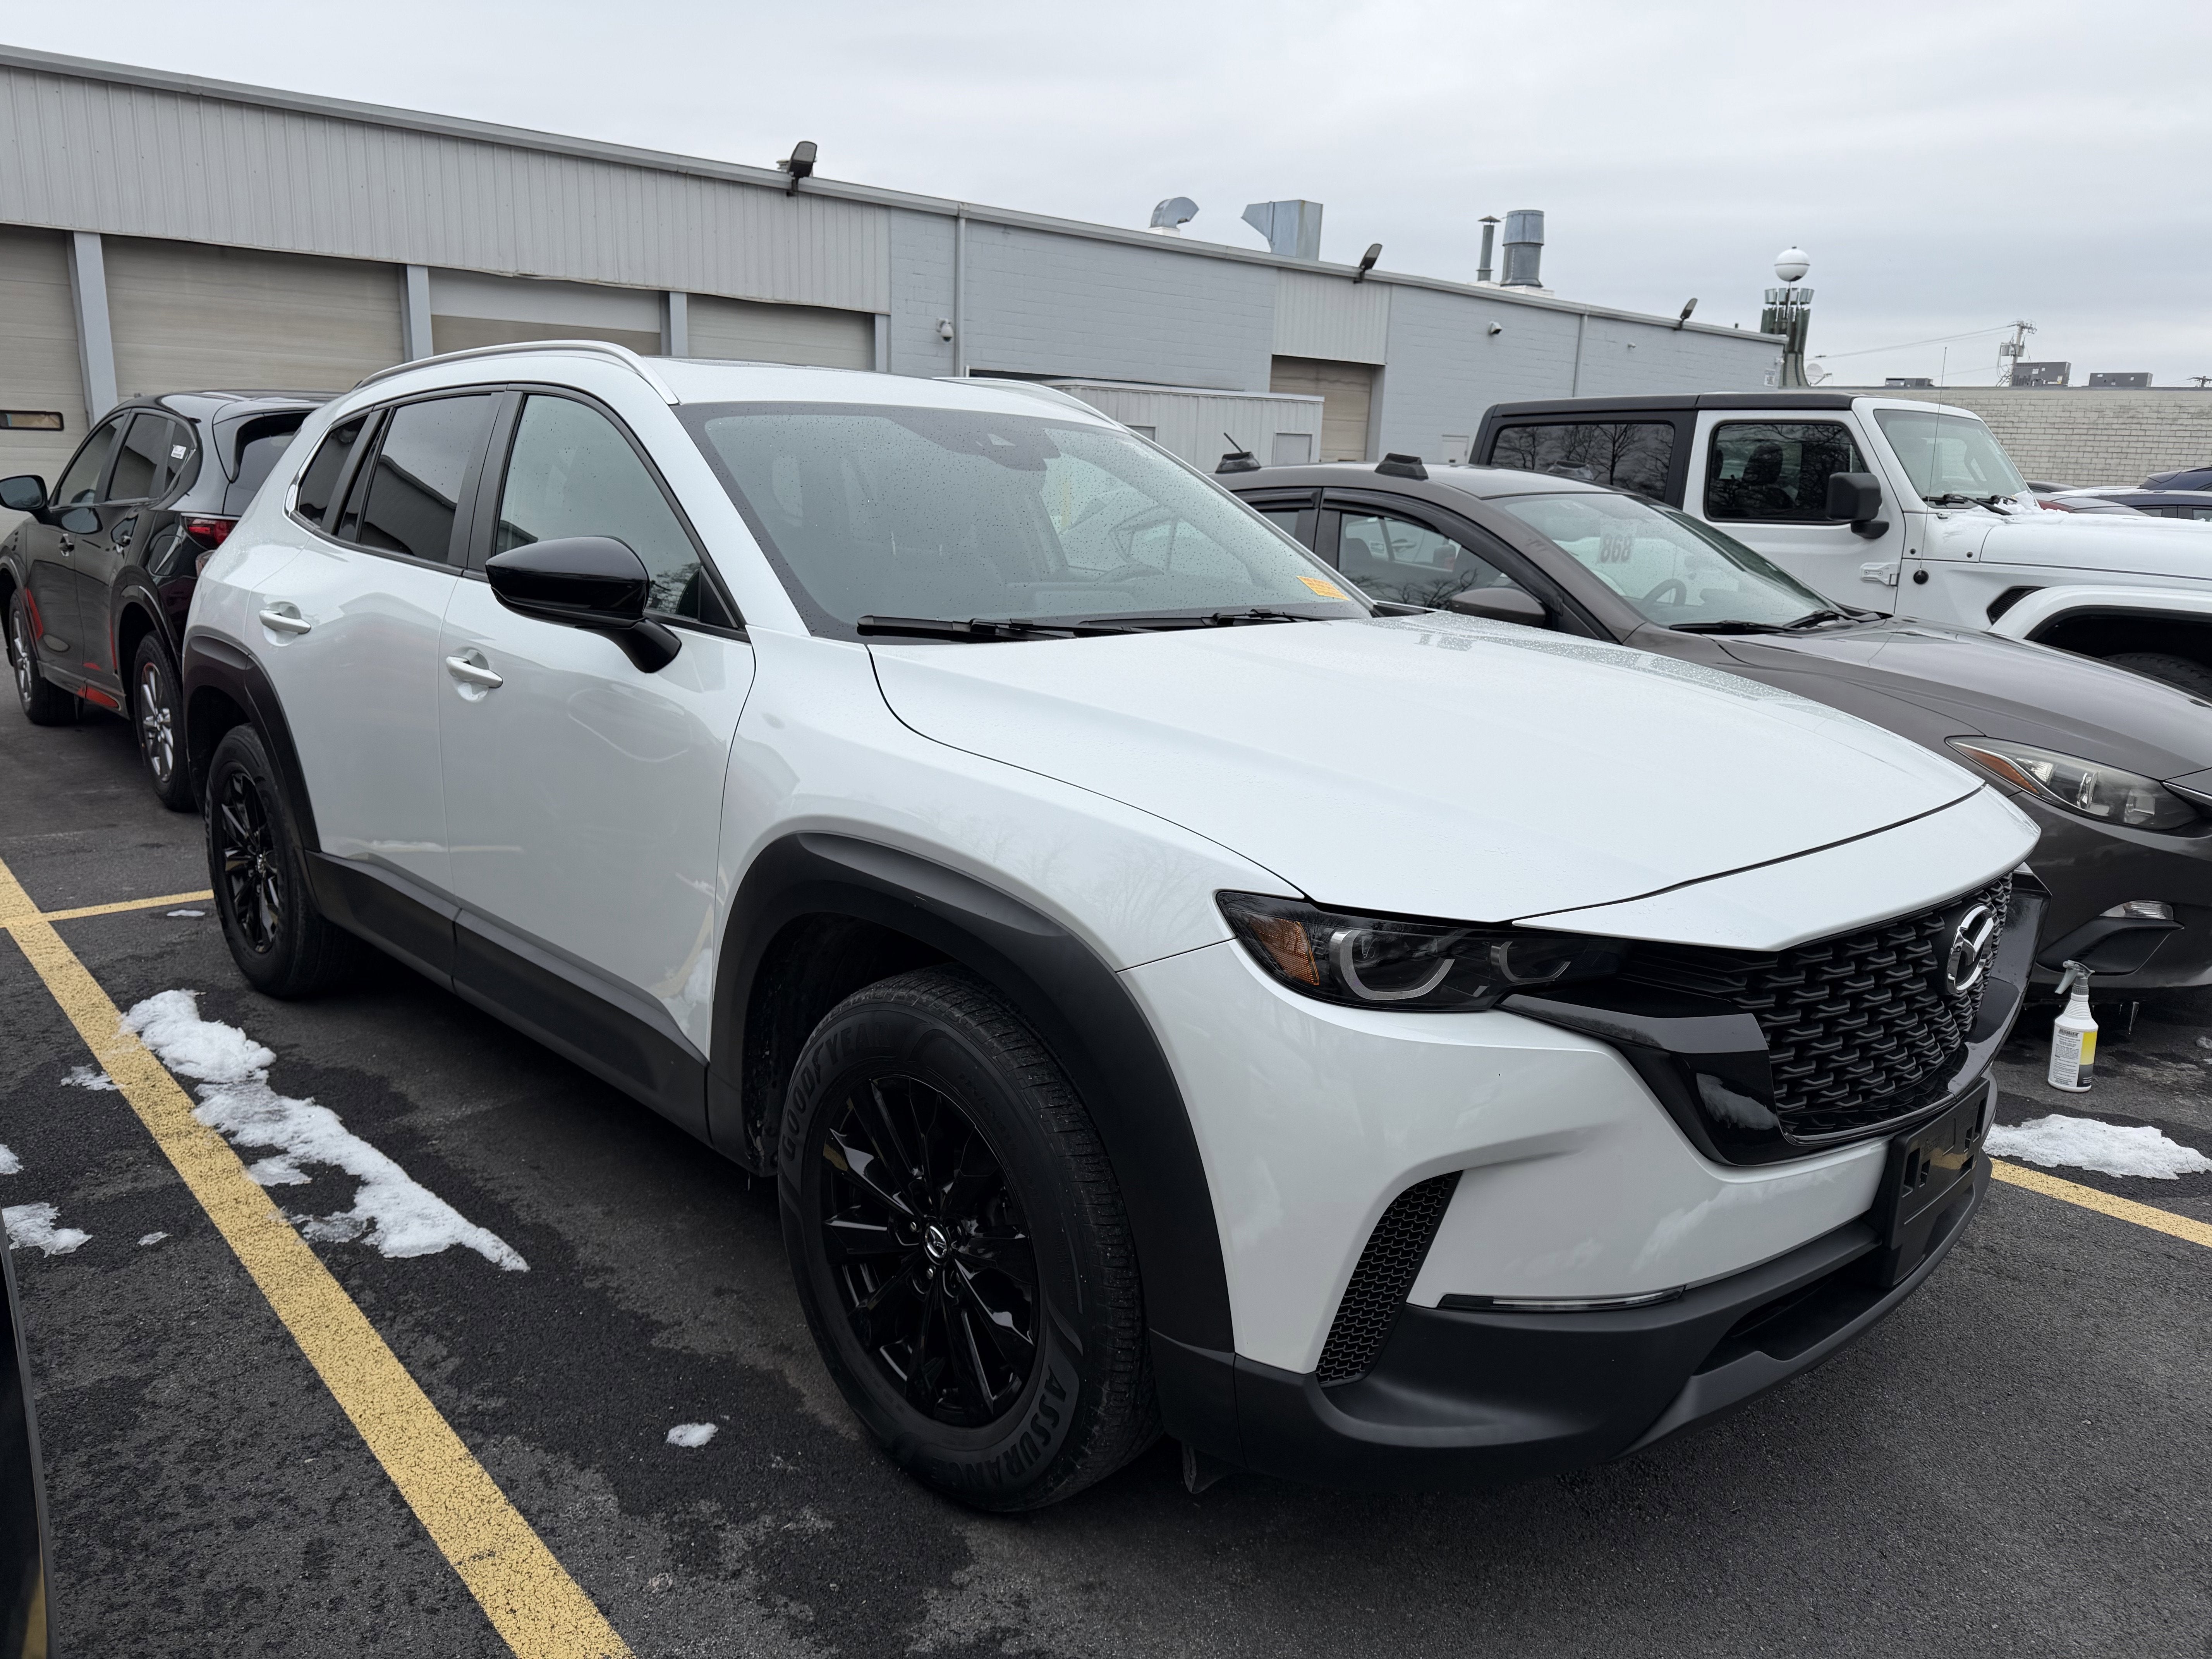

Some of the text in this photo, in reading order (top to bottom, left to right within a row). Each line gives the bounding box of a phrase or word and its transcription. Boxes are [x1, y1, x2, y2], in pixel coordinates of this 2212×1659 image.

[1600, 533, 1632, 563] 868
[782, 1021, 891, 1161] GOODYEAR
[931, 1364, 1067, 1487] ASSURANCE
